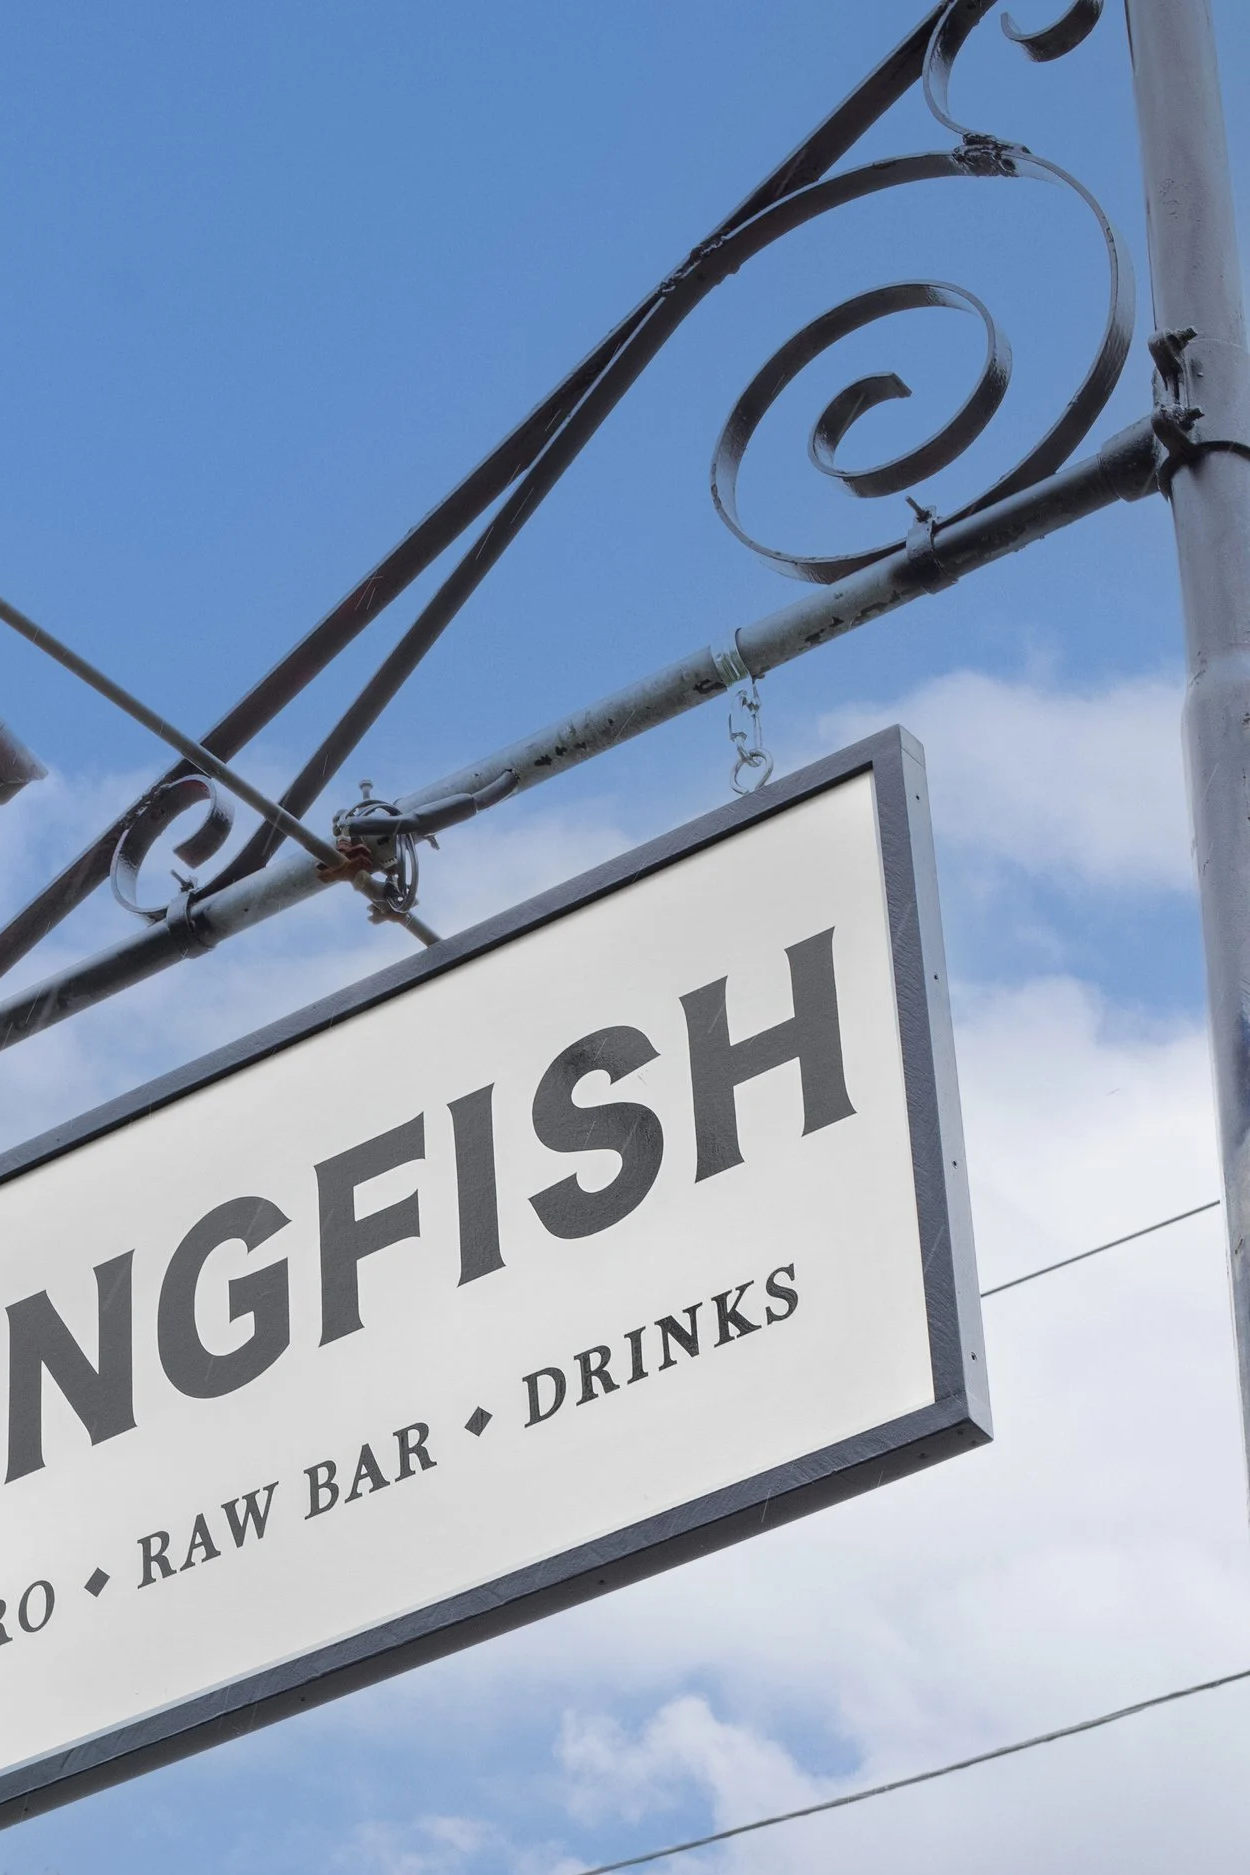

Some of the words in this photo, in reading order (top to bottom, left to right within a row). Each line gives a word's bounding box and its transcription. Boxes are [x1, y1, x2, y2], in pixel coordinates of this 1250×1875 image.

[136, 1480, 280, 1590] RAW
[303, 1422, 438, 1521] BAR
[521, 1261, 800, 1429] DRINKS
